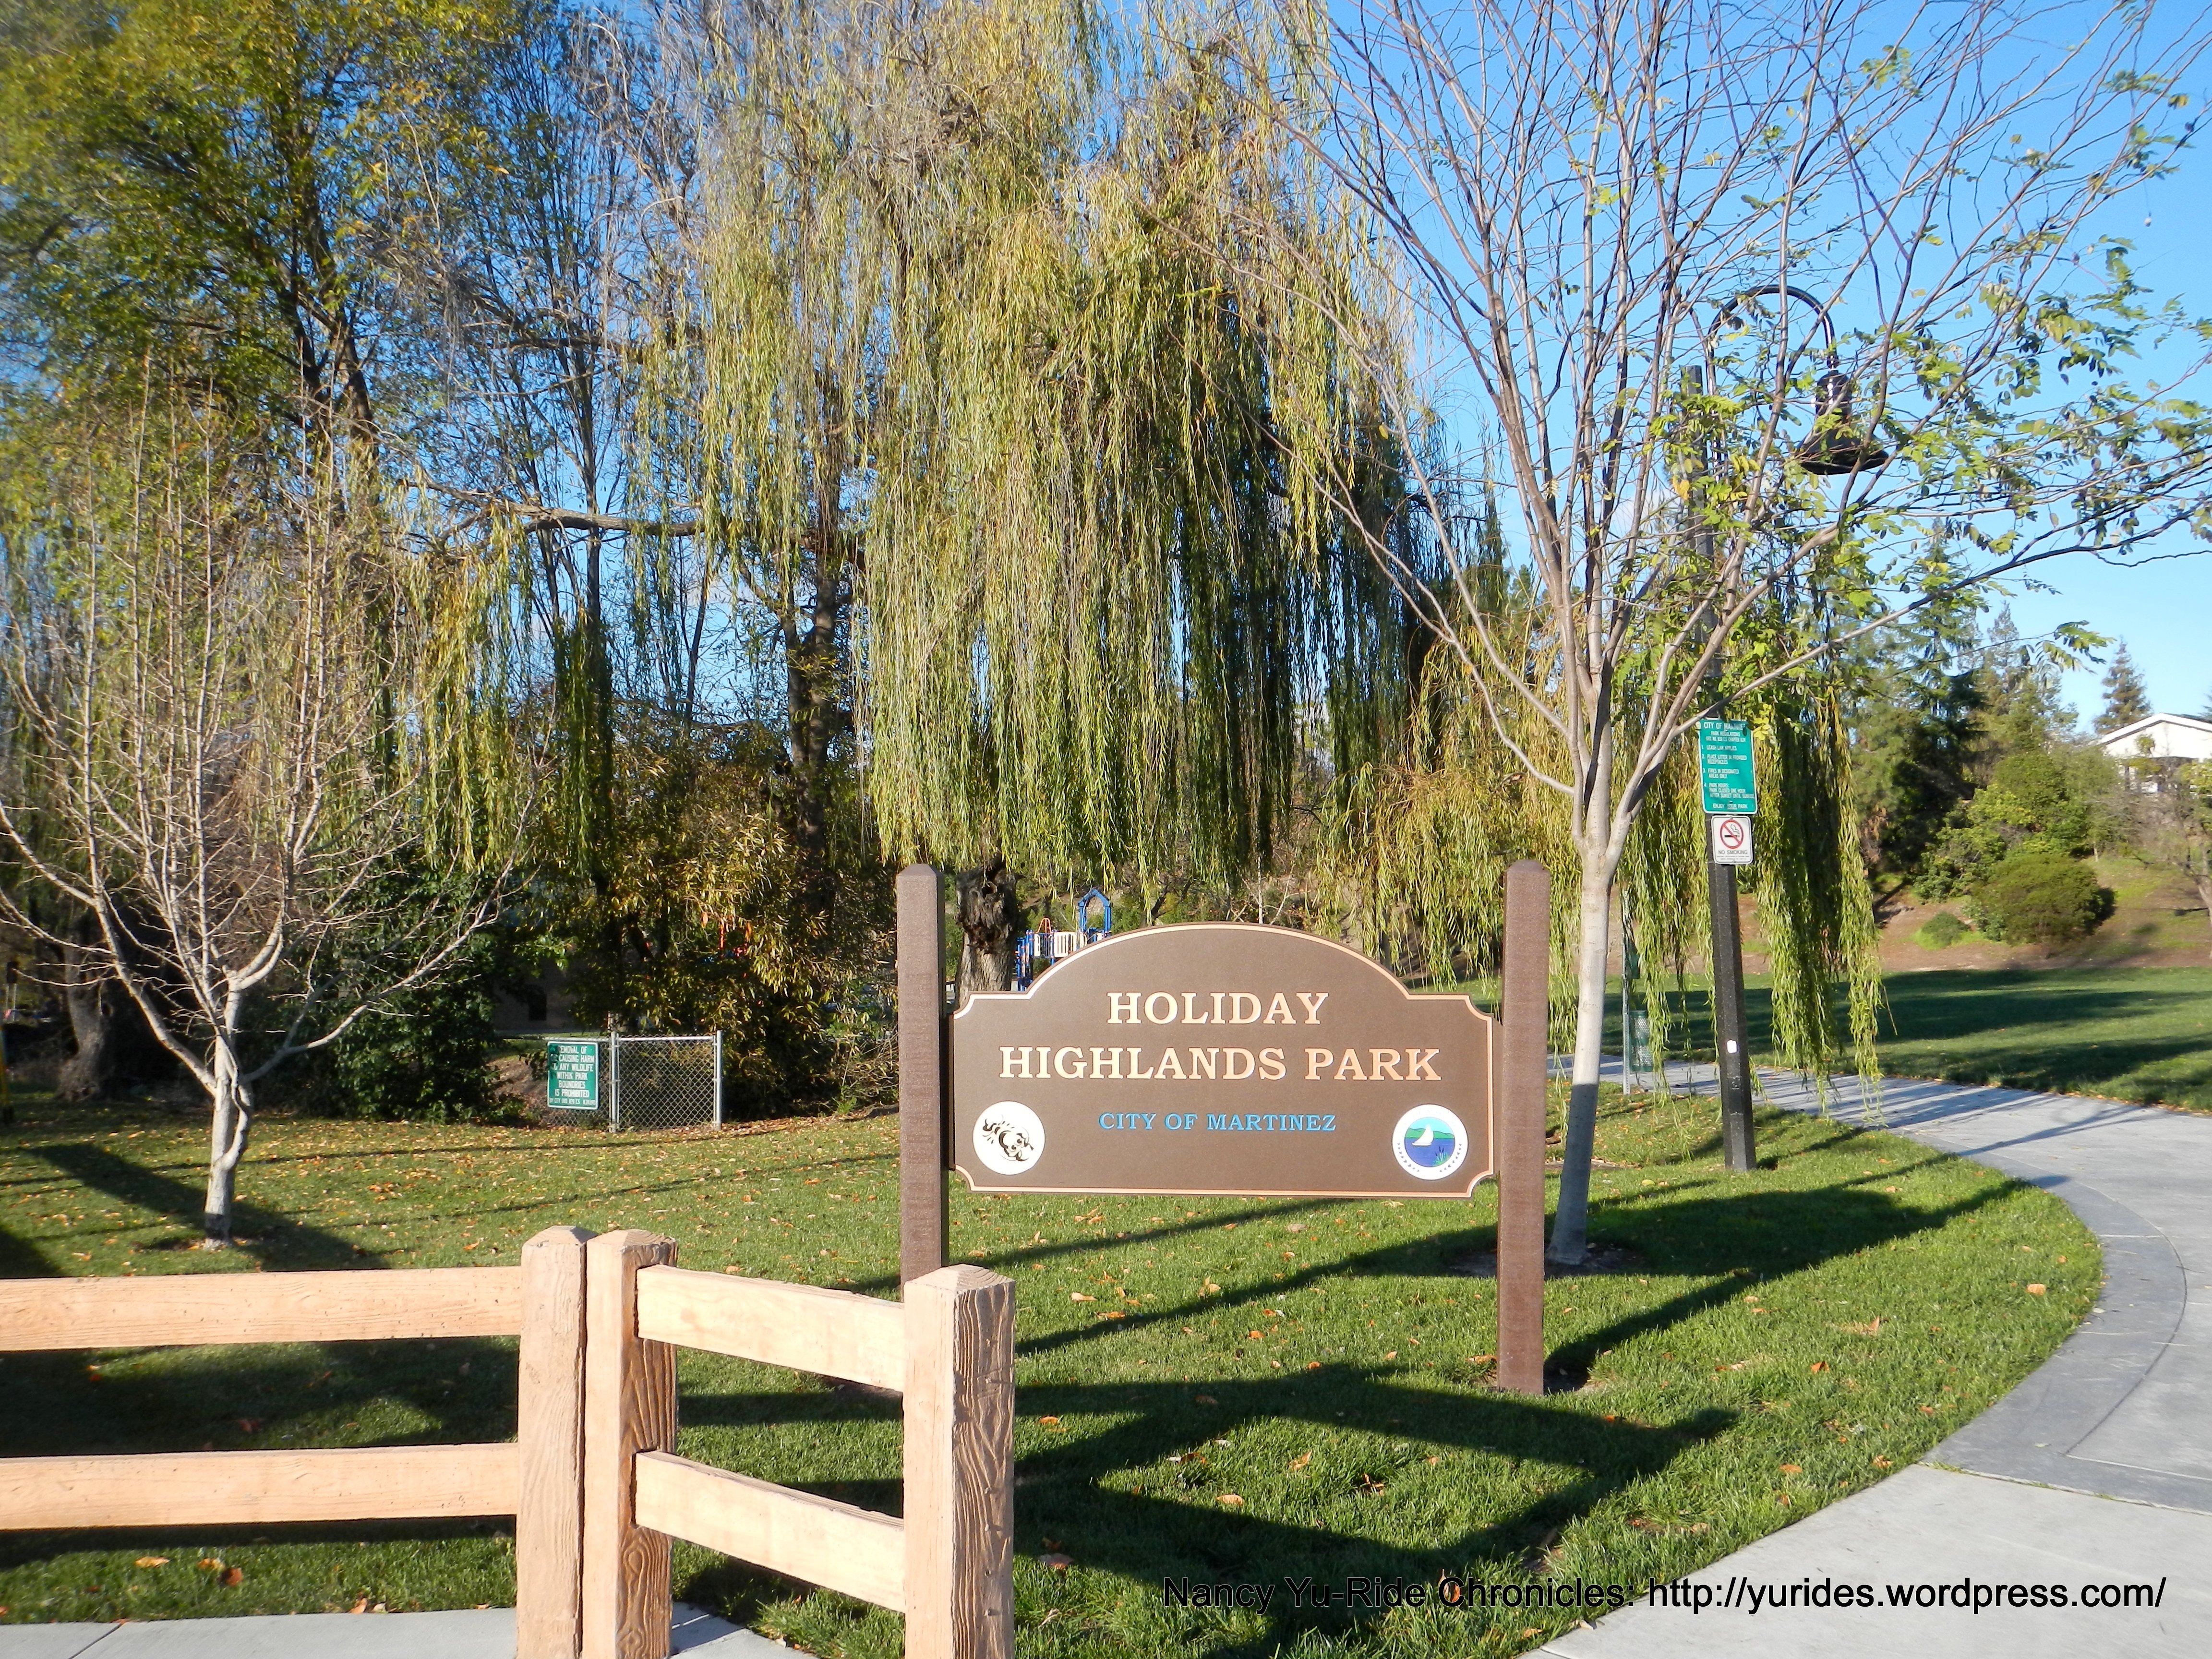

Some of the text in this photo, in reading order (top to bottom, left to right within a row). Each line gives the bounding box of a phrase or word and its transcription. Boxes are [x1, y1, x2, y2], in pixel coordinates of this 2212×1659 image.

[1107, 992, 1329, 1025] HOLIDAY
[580, 1046, 588, 1054] OF
[558, 1054, 579, 1062] CAUSING
[580, 1055, 595, 1063] HARM
[571, 1063, 593, 1072] WILDLIFE
[998, 1046, 1442, 1081] HIGHLANDS PARK
[575, 1072, 588, 1080] PARK
[561, 1089, 590, 1098] PROHIBITED
[1098, 1112, 1336, 1132] CITY OF MARTINEZ
